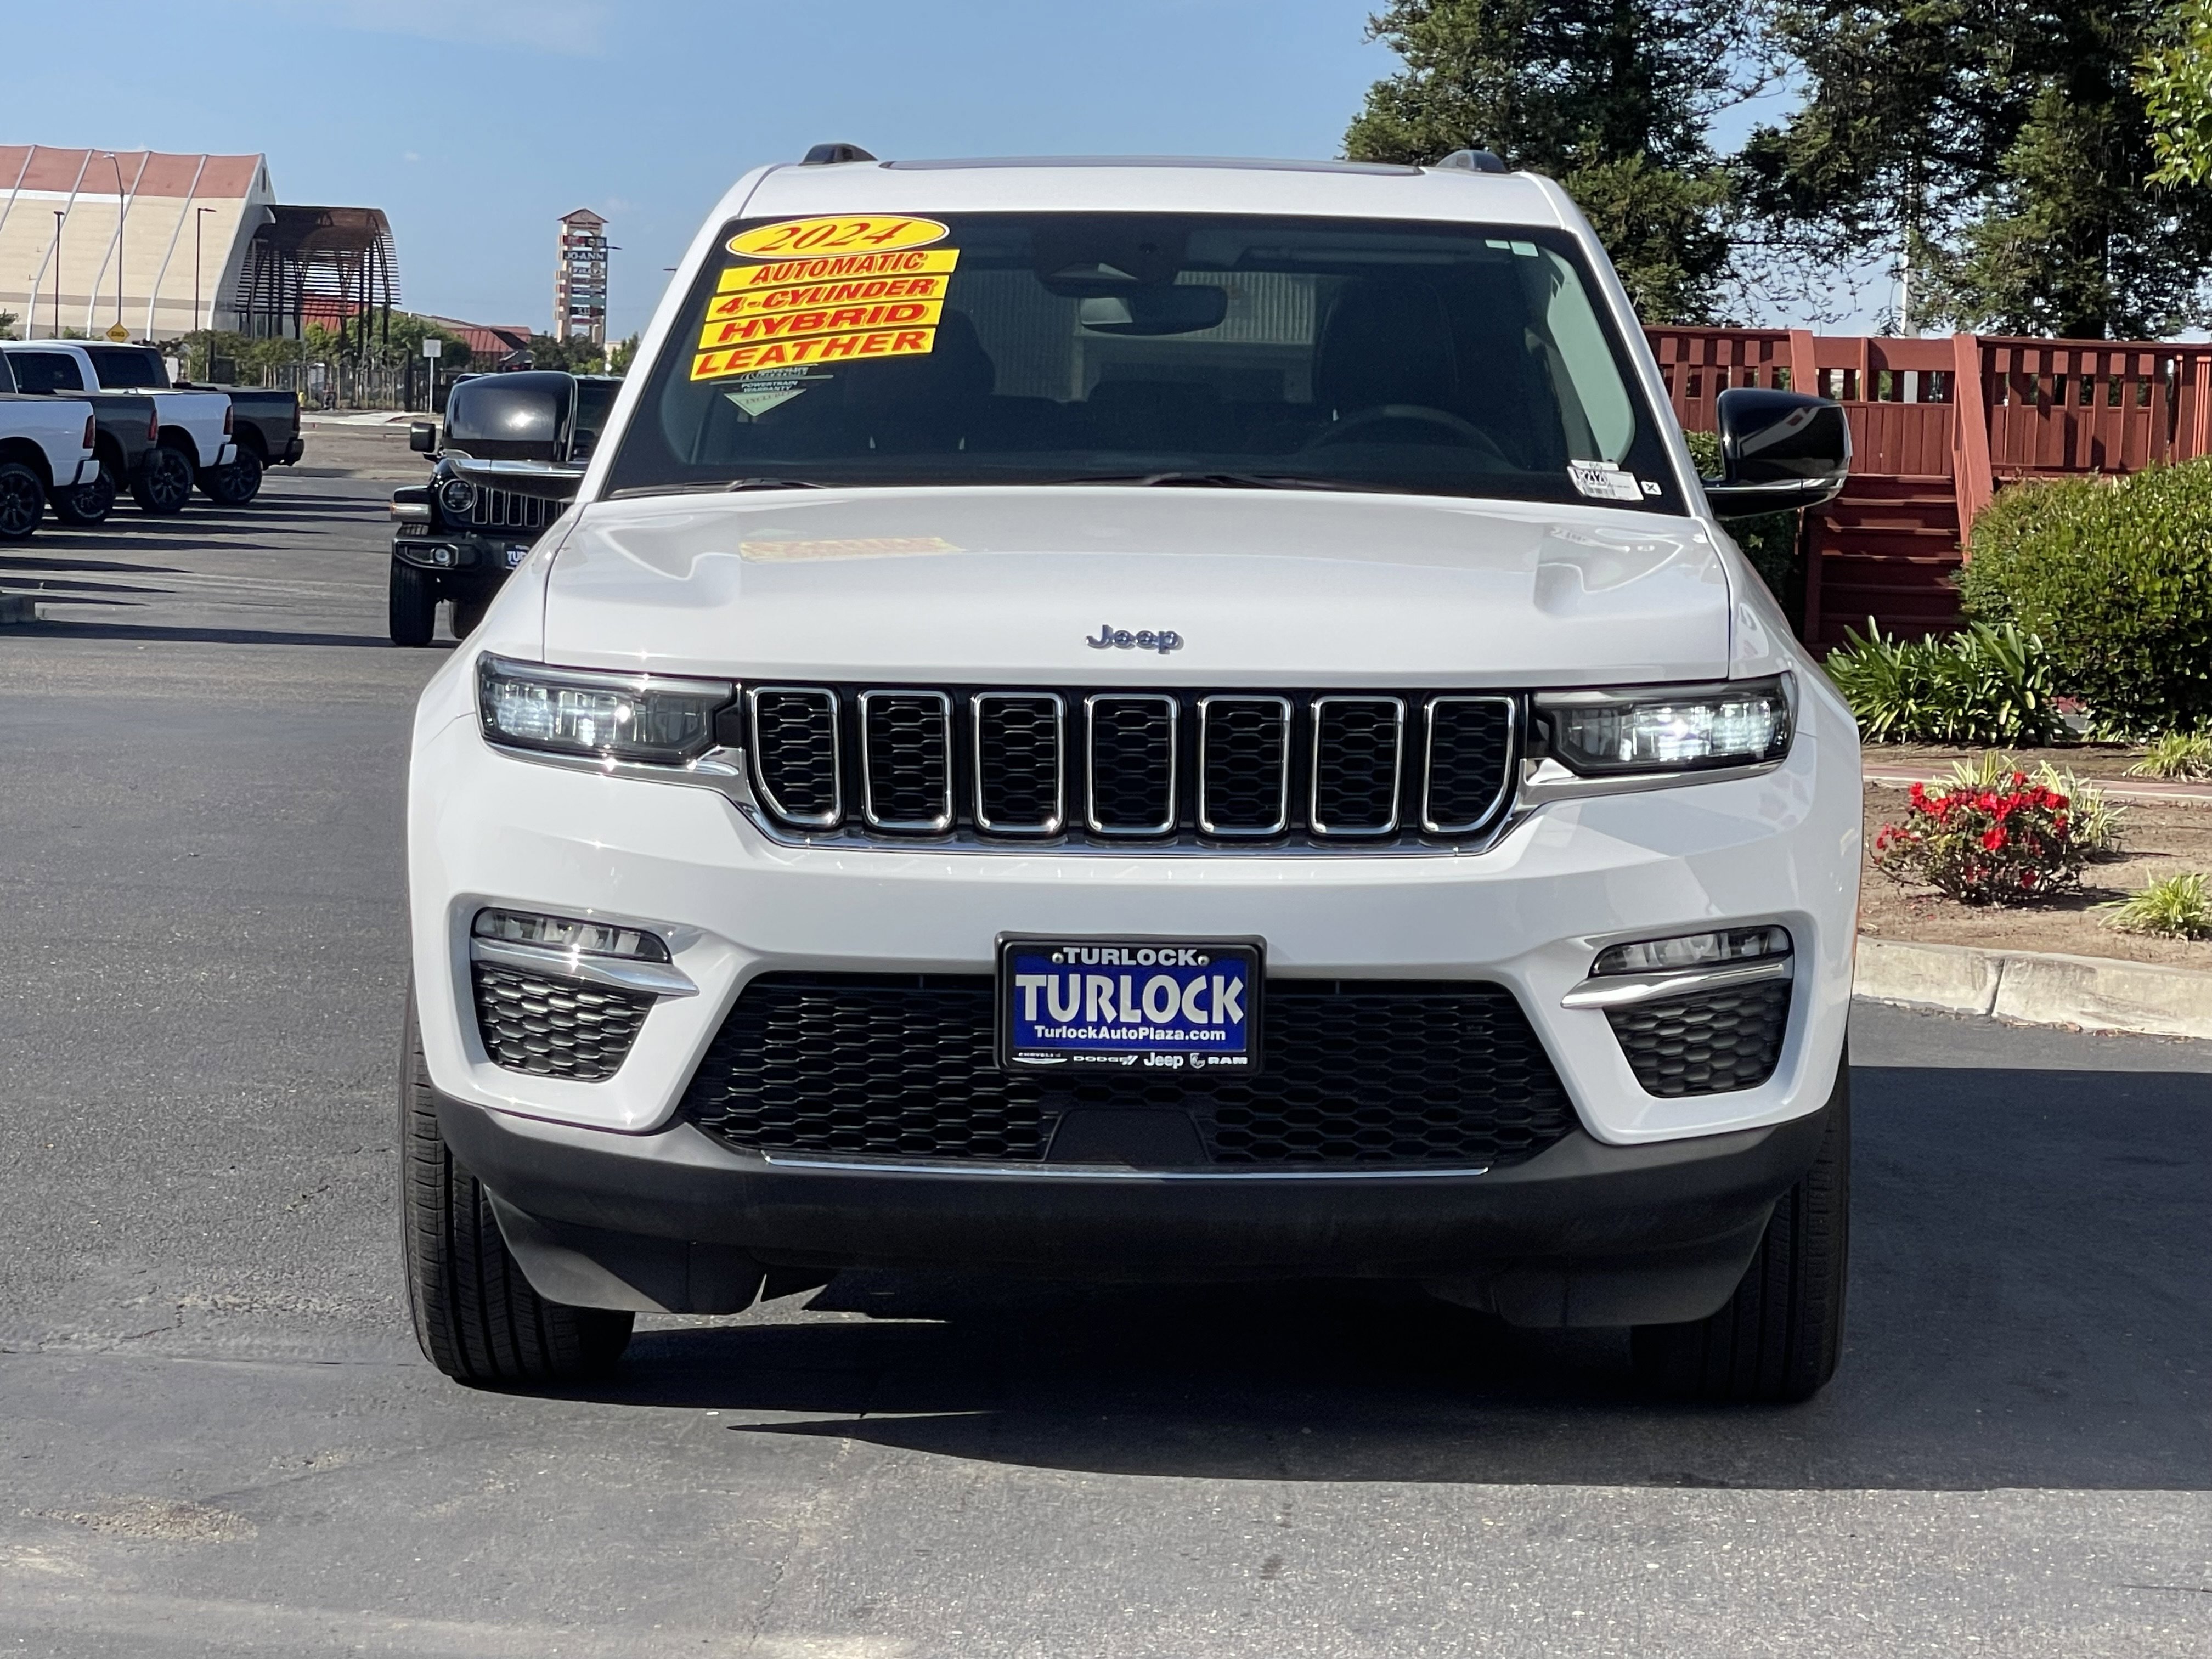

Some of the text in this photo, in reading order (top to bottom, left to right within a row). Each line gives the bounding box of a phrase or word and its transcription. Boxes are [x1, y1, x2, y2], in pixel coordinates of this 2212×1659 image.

[752, 221, 913, 253] 2024
[749, 252, 929, 285] AUTOMATIC
[716, 278, 939, 315] 4-CYLINDER
[718, 303, 930, 342] HYBRID
[695, 330, 932, 376] LEATHER
[741, 380, 798, 389] POWERTRAIN
[1086, 624, 1184, 655] Jeep
[1063, 947, 1198, 966] TURLOCK
[1015, 974, 1244, 1025] TURLOCK
[1034, 1025, 1226, 1041] TurlockAutoPlaza.com
[1143, 1052, 1184, 1069] Jeep
[1207, 1057, 1248, 1065] RAM
